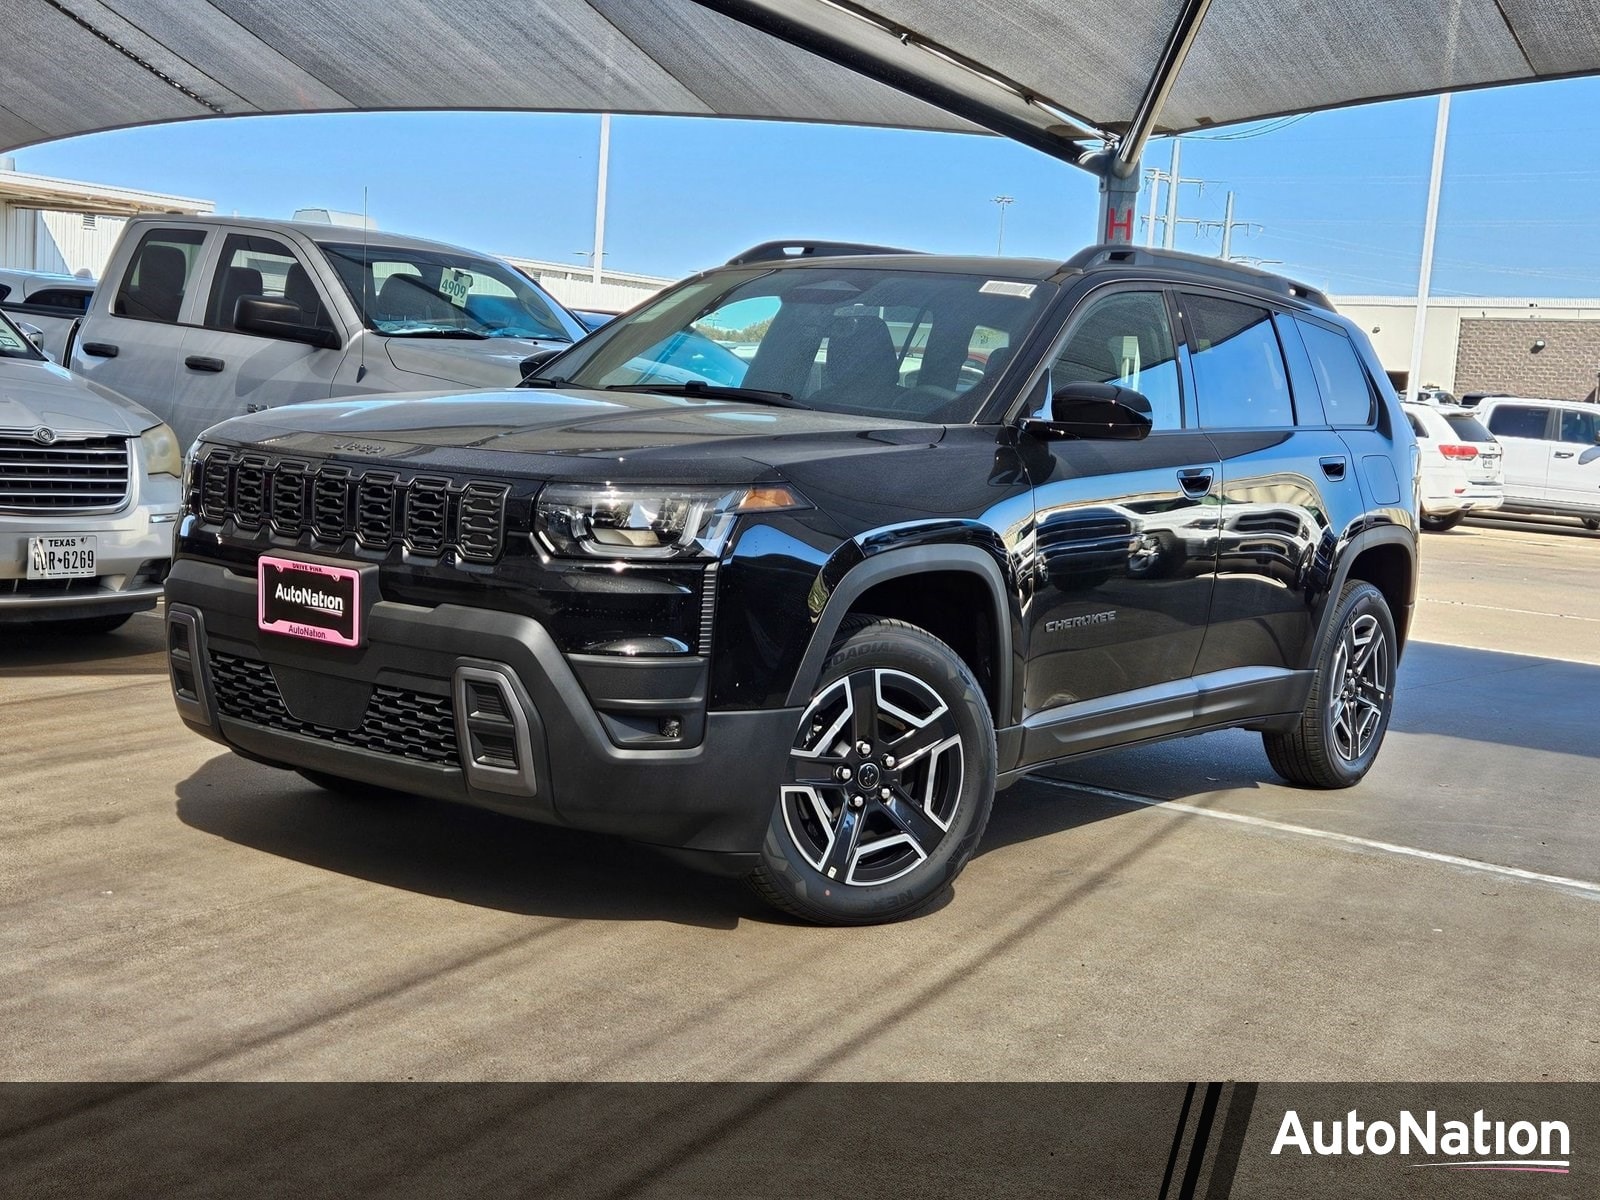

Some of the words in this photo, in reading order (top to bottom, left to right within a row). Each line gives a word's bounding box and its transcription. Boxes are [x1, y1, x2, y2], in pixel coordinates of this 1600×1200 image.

[1108, 207, 1133, 241] H
[442, 279, 467, 299] 4909
[333, 441, 386, 455] Jeep
[48, 538, 76, 547] TEXAS
[63, 550, 94, 570] 6269
[275, 583, 344, 611] AutoNation
[1045, 610, 1117, 633] CHEROKEE
[288, 625, 326, 639] AutoNation
